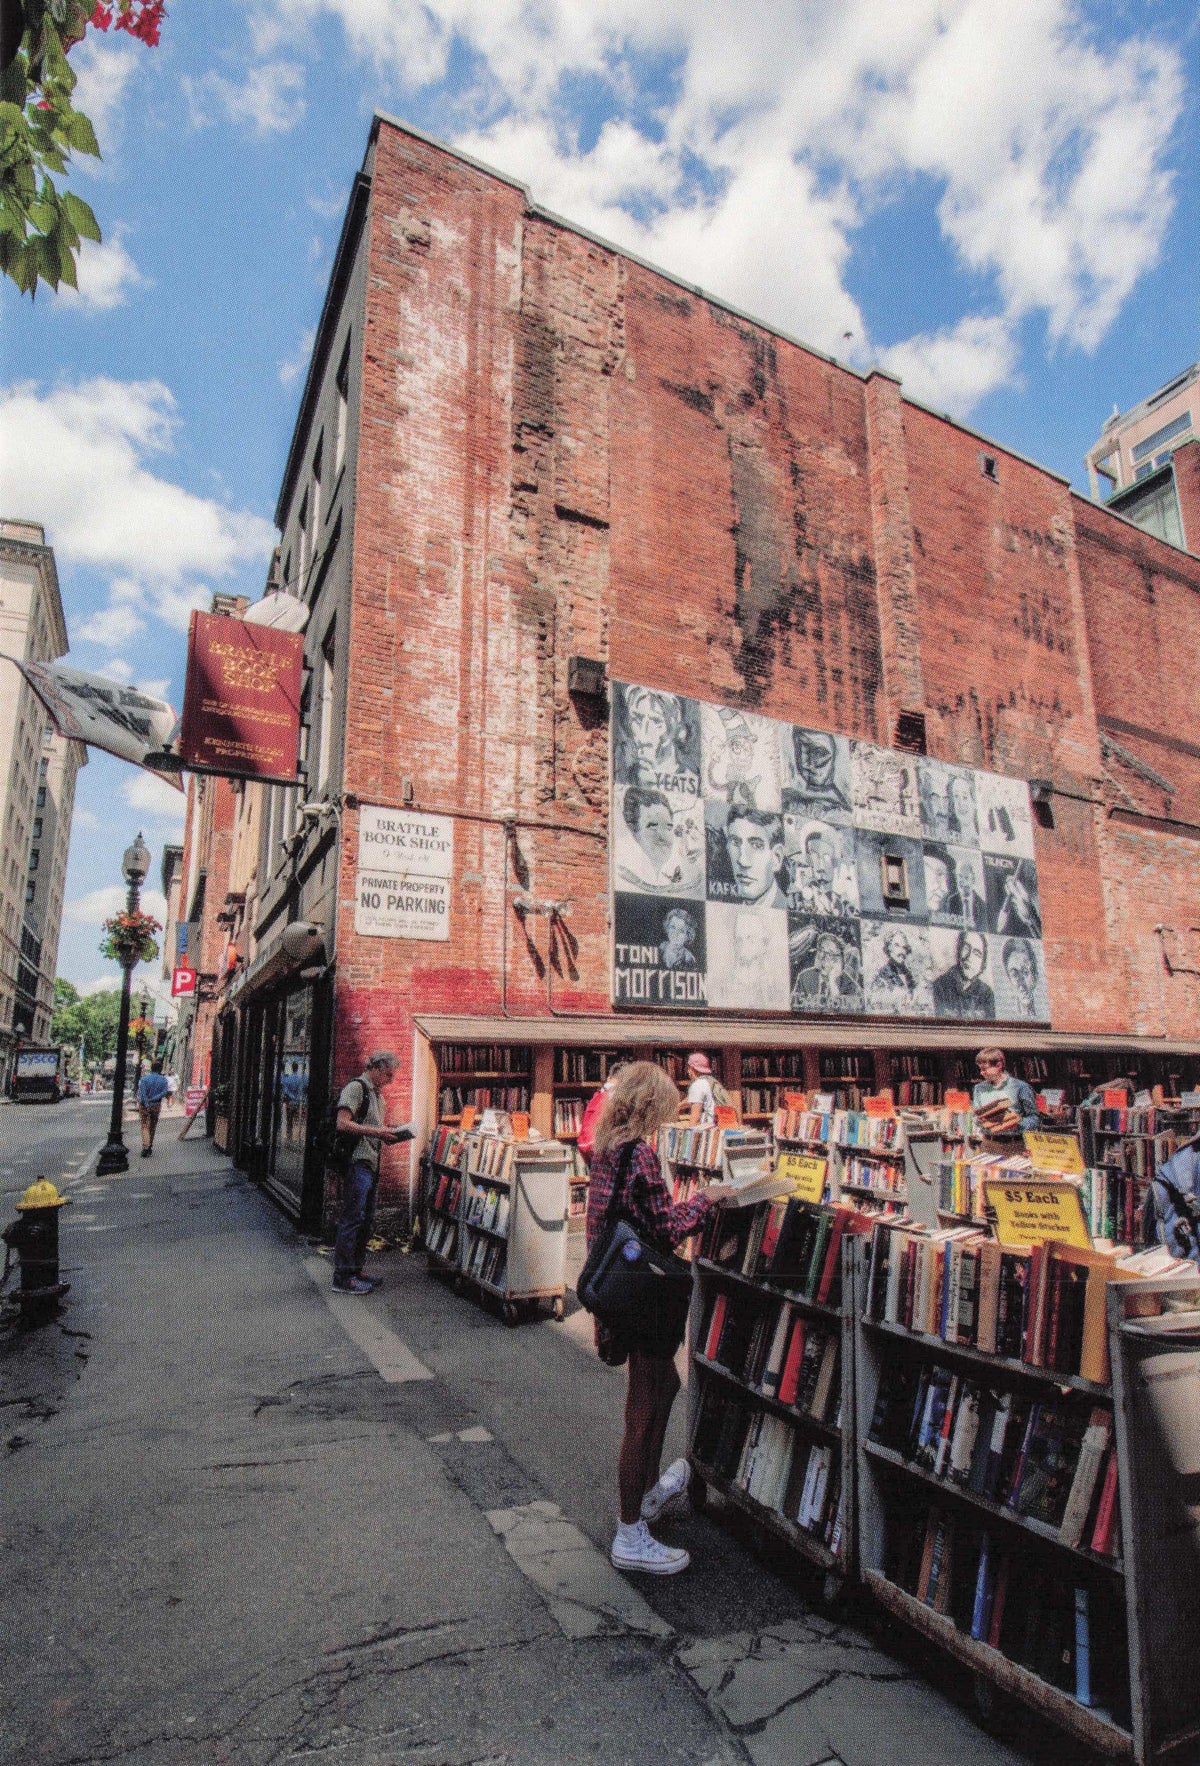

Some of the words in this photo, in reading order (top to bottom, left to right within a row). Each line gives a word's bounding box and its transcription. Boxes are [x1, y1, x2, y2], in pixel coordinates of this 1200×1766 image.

[209, 640, 294, 671] BRATTLE
[222, 658, 279, 682] BOOK
[223, 671, 277, 693] SHOP
[654, 772, 697, 795] YEATS
[377, 819, 440, 838] BRATTLE
[364, 831, 407, 848] BOOK
[409, 836, 451, 853] SHOP
[361, 876, 398, 891] PRIVATE
[400, 880, 445, 895] PROPERTY
[361, 892, 381, 910] NO
[386, 894, 446, 915] PARKING
[615, 943, 659, 965] TONI
[175, 971, 192, 989] P
[1004, 1190, 1023, 1203] $5
[1025, 1191, 1060, 1205] Each
[1009, 1220, 1037, 1229] Yellow
[1013, 1209, 1039, 1219] Books
[1040, 1212, 1060, 1220] with
